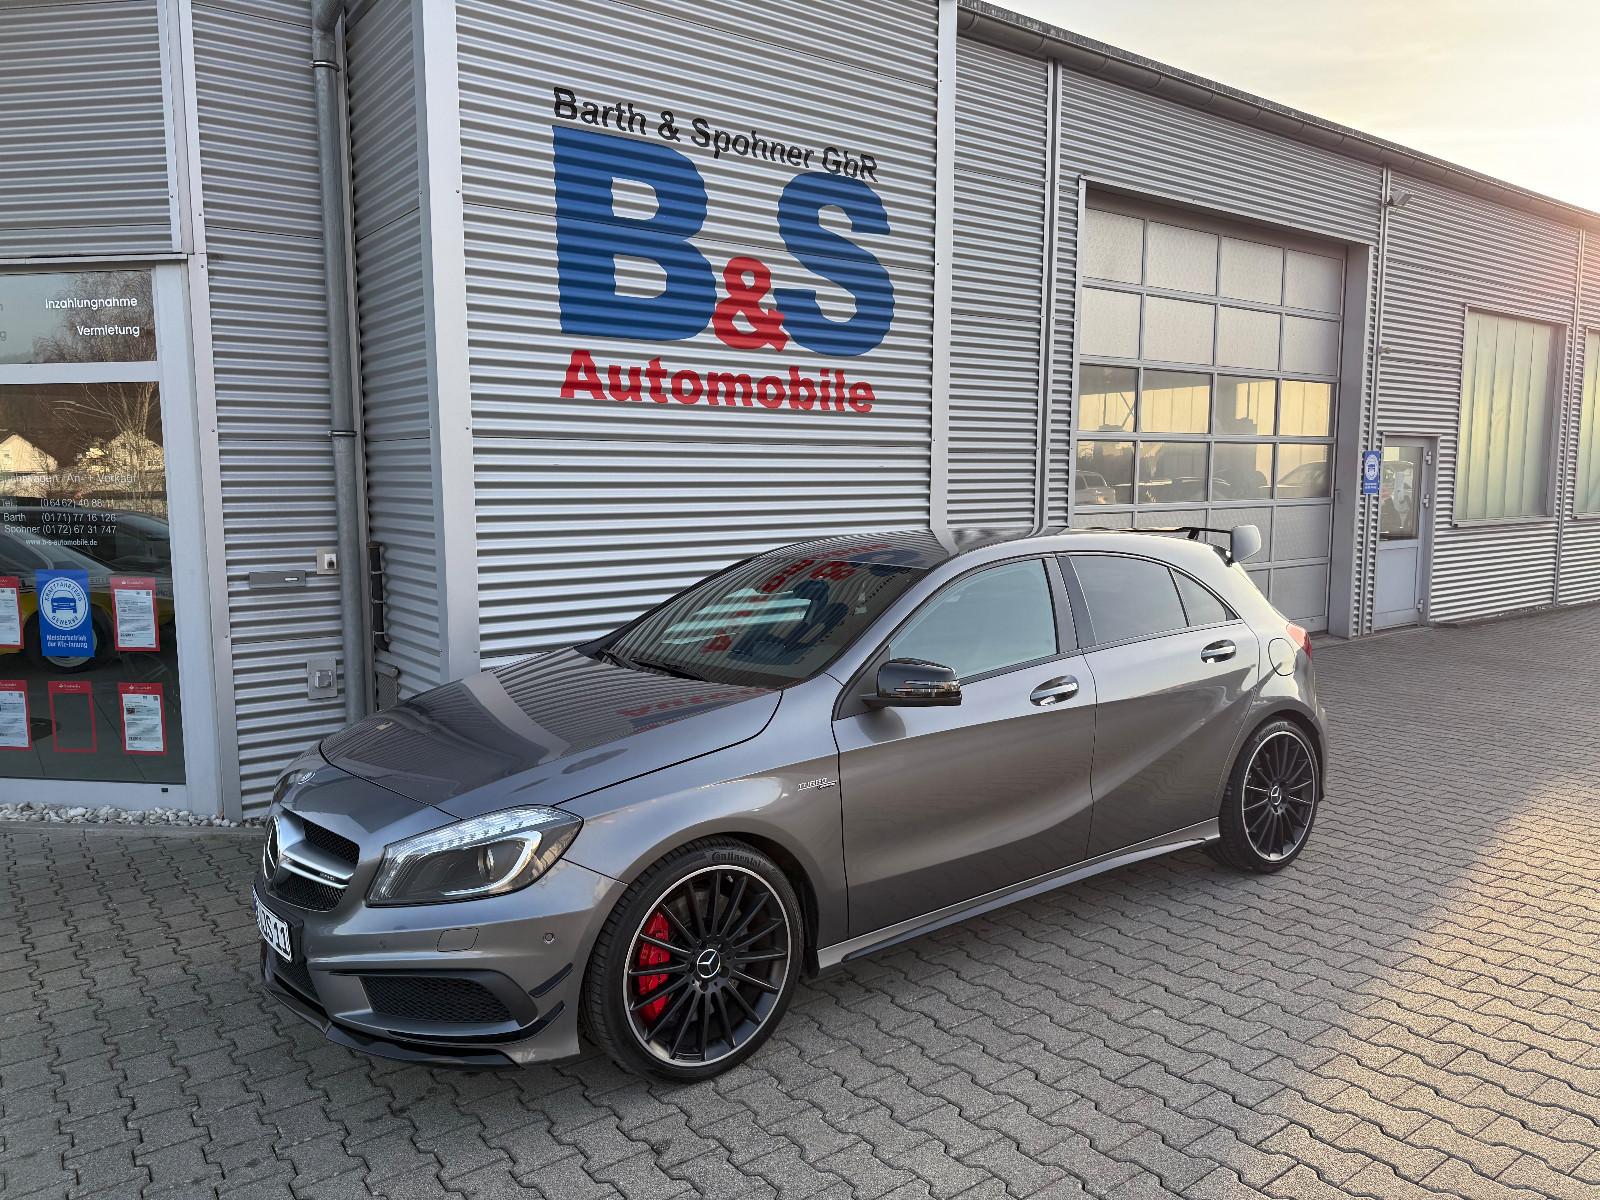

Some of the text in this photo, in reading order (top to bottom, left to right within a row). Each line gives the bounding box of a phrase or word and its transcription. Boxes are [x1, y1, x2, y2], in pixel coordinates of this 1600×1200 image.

[553, 87, 878, 183] Barth & Spohner GbR
[45, 297, 138, 310] Inzahlungnahme
[77, 324, 140, 338] Vermietung
[560, 350, 876, 413] Automobile
[3, 513, 27, 522] Barth
[74, 514, 84, 522] 77
[101, 514, 117, 522] 126
[4, 525, 41, 535] Spohner
[73, 525, 85, 534] 67
[87, 525, 98, 534] 31
[101, 526, 117, 534] 747
[711, 851, 763, 869] Continental
